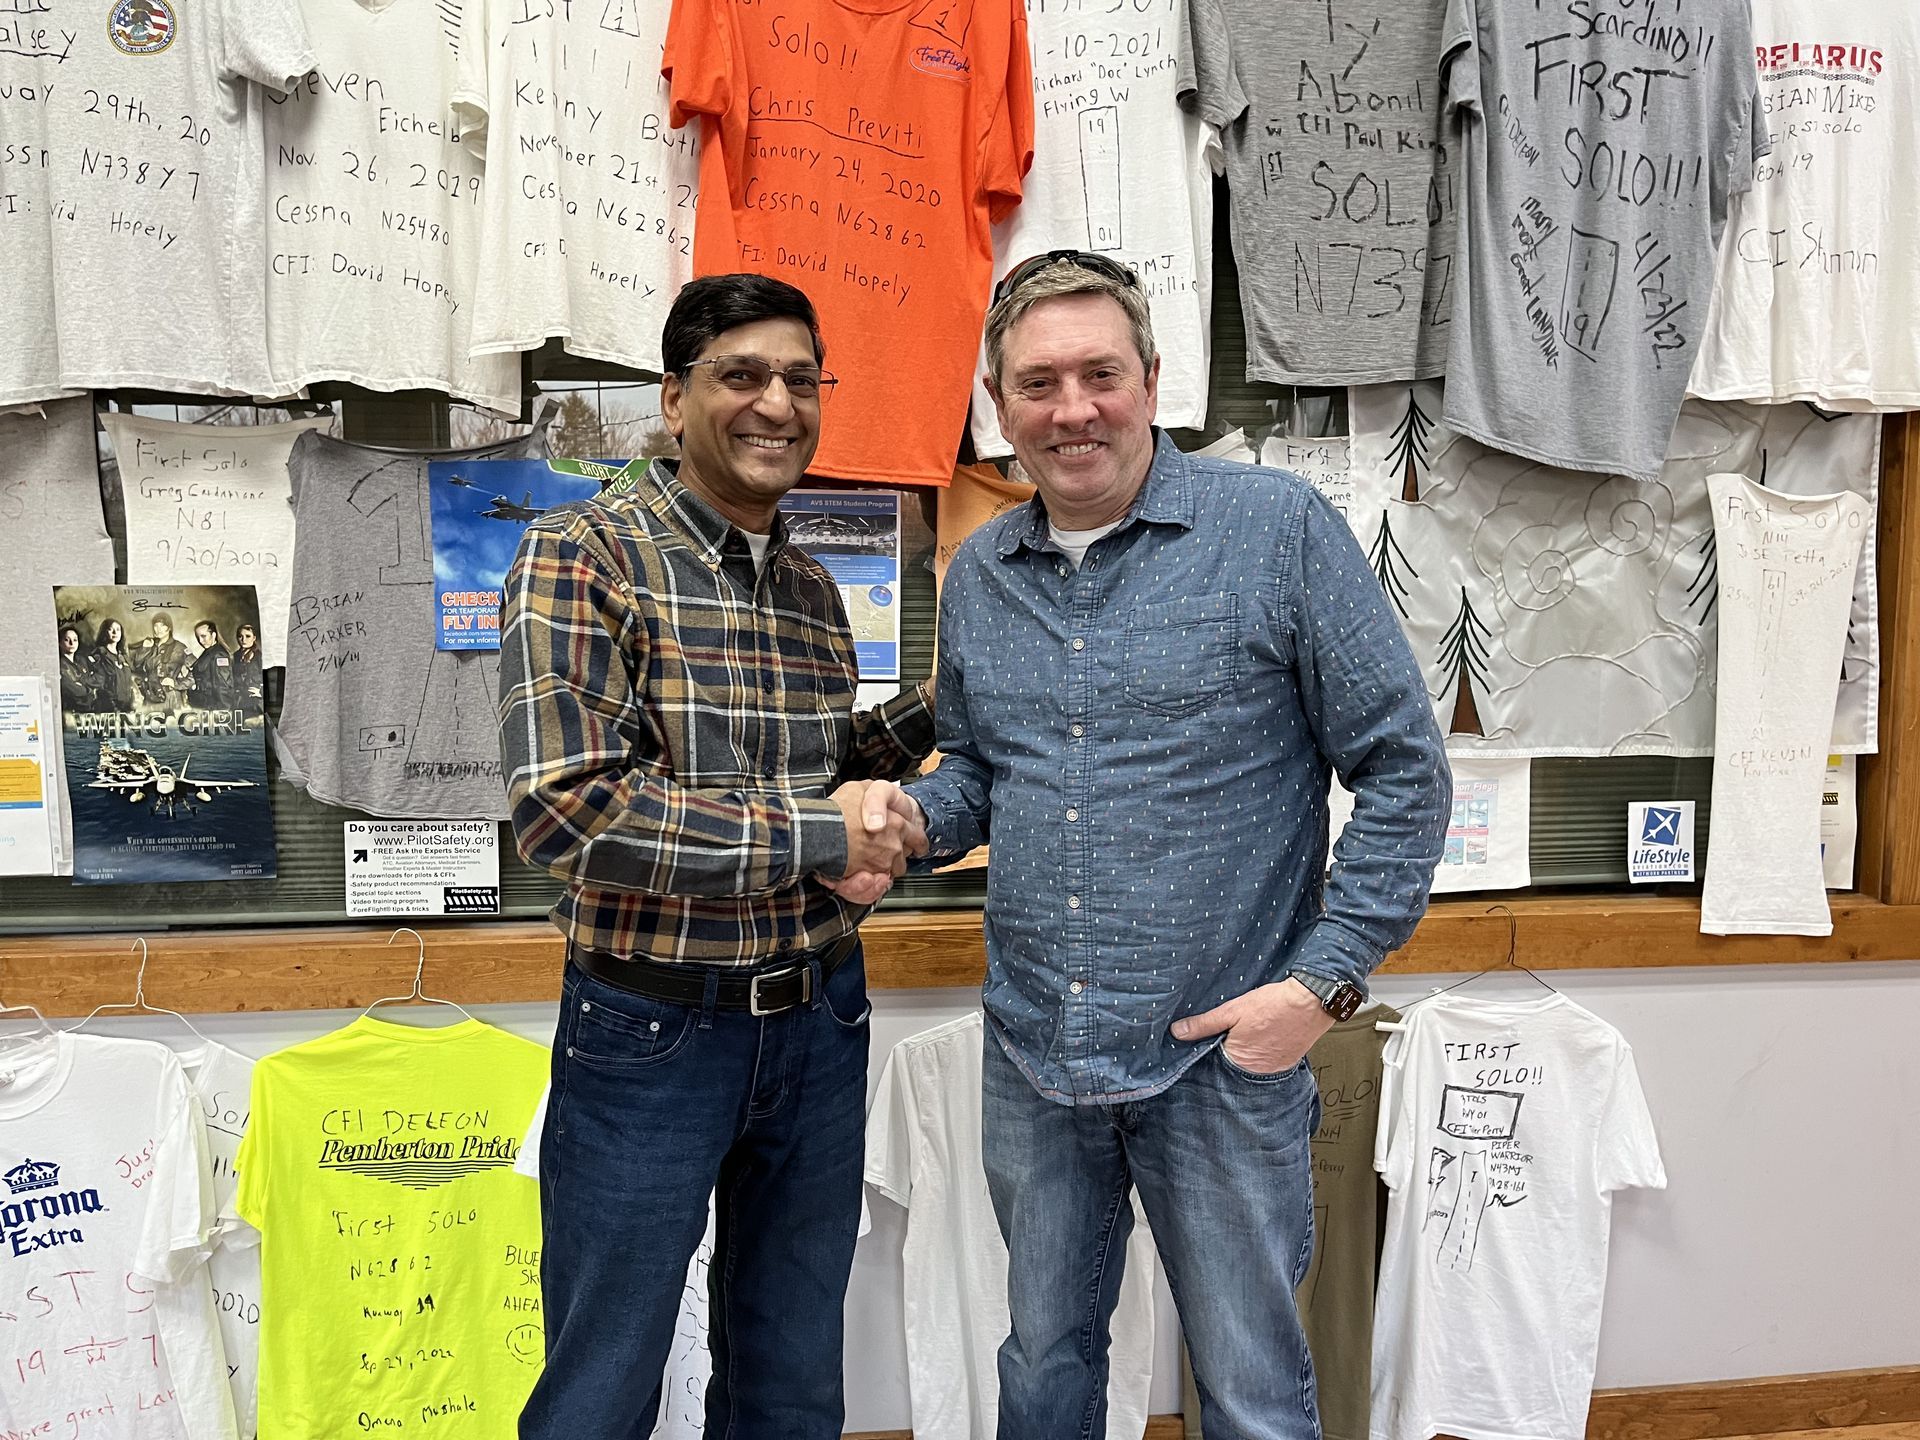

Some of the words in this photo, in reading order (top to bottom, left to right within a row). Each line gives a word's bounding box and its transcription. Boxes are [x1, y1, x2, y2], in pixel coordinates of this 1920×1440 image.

[1034, 68, 1082, 94] Richard
[1134, 53, 1178, 78] Lynch
[1524, 32, 1691, 124] FIRST
[1044, 88, 1098, 118] Flying
[1110, 86, 1130, 102] W
[749, 86, 814, 117] Chris
[847, 107, 922, 150] Previti
[1344, 122, 1384, 150] Paul
[279, 144, 317, 167] Nov.
[341, 151, 388, 185] 26,
[410, 163, 480, 205] 2019
[749, 136, 821, 169] January
[833, 155, 865, 185] 24,
[880, 172, 942, 208] 2020
[275, 195, 351, 226] Cessna
[381, 210, 449, 246] N25480
[596, 197, 690, 256] N62862
[744, 177, 819, 217] Cessna
[837, 202, 927, 249] N62862
[110, 211, 178, 250] Hopely
[272, 254, 316, 275] CFI:
[332, 253, 384, 282] David
[737, 240, 766, 262] FI:
[777, 247, 827, 272] David
[843, 263, 911, 307] Hopely
[136, 438, 192, 468] First
[202, 449, 248, 471] Solo
[1287, 445, 1333, 465] First
[579, 462, 611, 478] SHORT
[140, 476, 183, 502] Greg
[1727, 496, 1773, 523] First
[1788, 500, 1861, 529] Solo
[441, 591, 500, 606] CHECK
[300, 621, 367, 652] PARKER
[443, 615, 471, 629] FLY
[75, 710, 168, 739] WING
[178, 709, 251, 737] GIRL
[350, 824, 365, 832] Do
[368, 825, 388, 834] you
[391, 824, 414, 832] care
[417, 823, 448, 832] about
[451, 823, 490, 833] safety?
[374, 835, 494, 847] www.PilotSafety.org
[1633, 849, 1690, 866] LifeStyle
[1444, 1042, 1521, 1063] FIRST
[1474, 1066, 1542, 1088] SOLO!!
[1320, 1077, 1378, 1107] OLO!
[322, 1109, 364, 1135] CFI
[1447, 1123, 1468, 1134] CFI
[318, 1136, 455, 1163] Pemberton
[1491, 1141, 1520, 1150] PIPER
[1491, 1152, 1534, 1164] WARRIOR
[0, 1189, 104, 1228] orona
[332, 1210, 396, 1237] First
[9, 1228, 84, 1258] Extra
[505, 1245, 539, 1267] BLUE
[351, 1255, 433, 1281] N62862
[17, 1350, 46, 1383] 19
